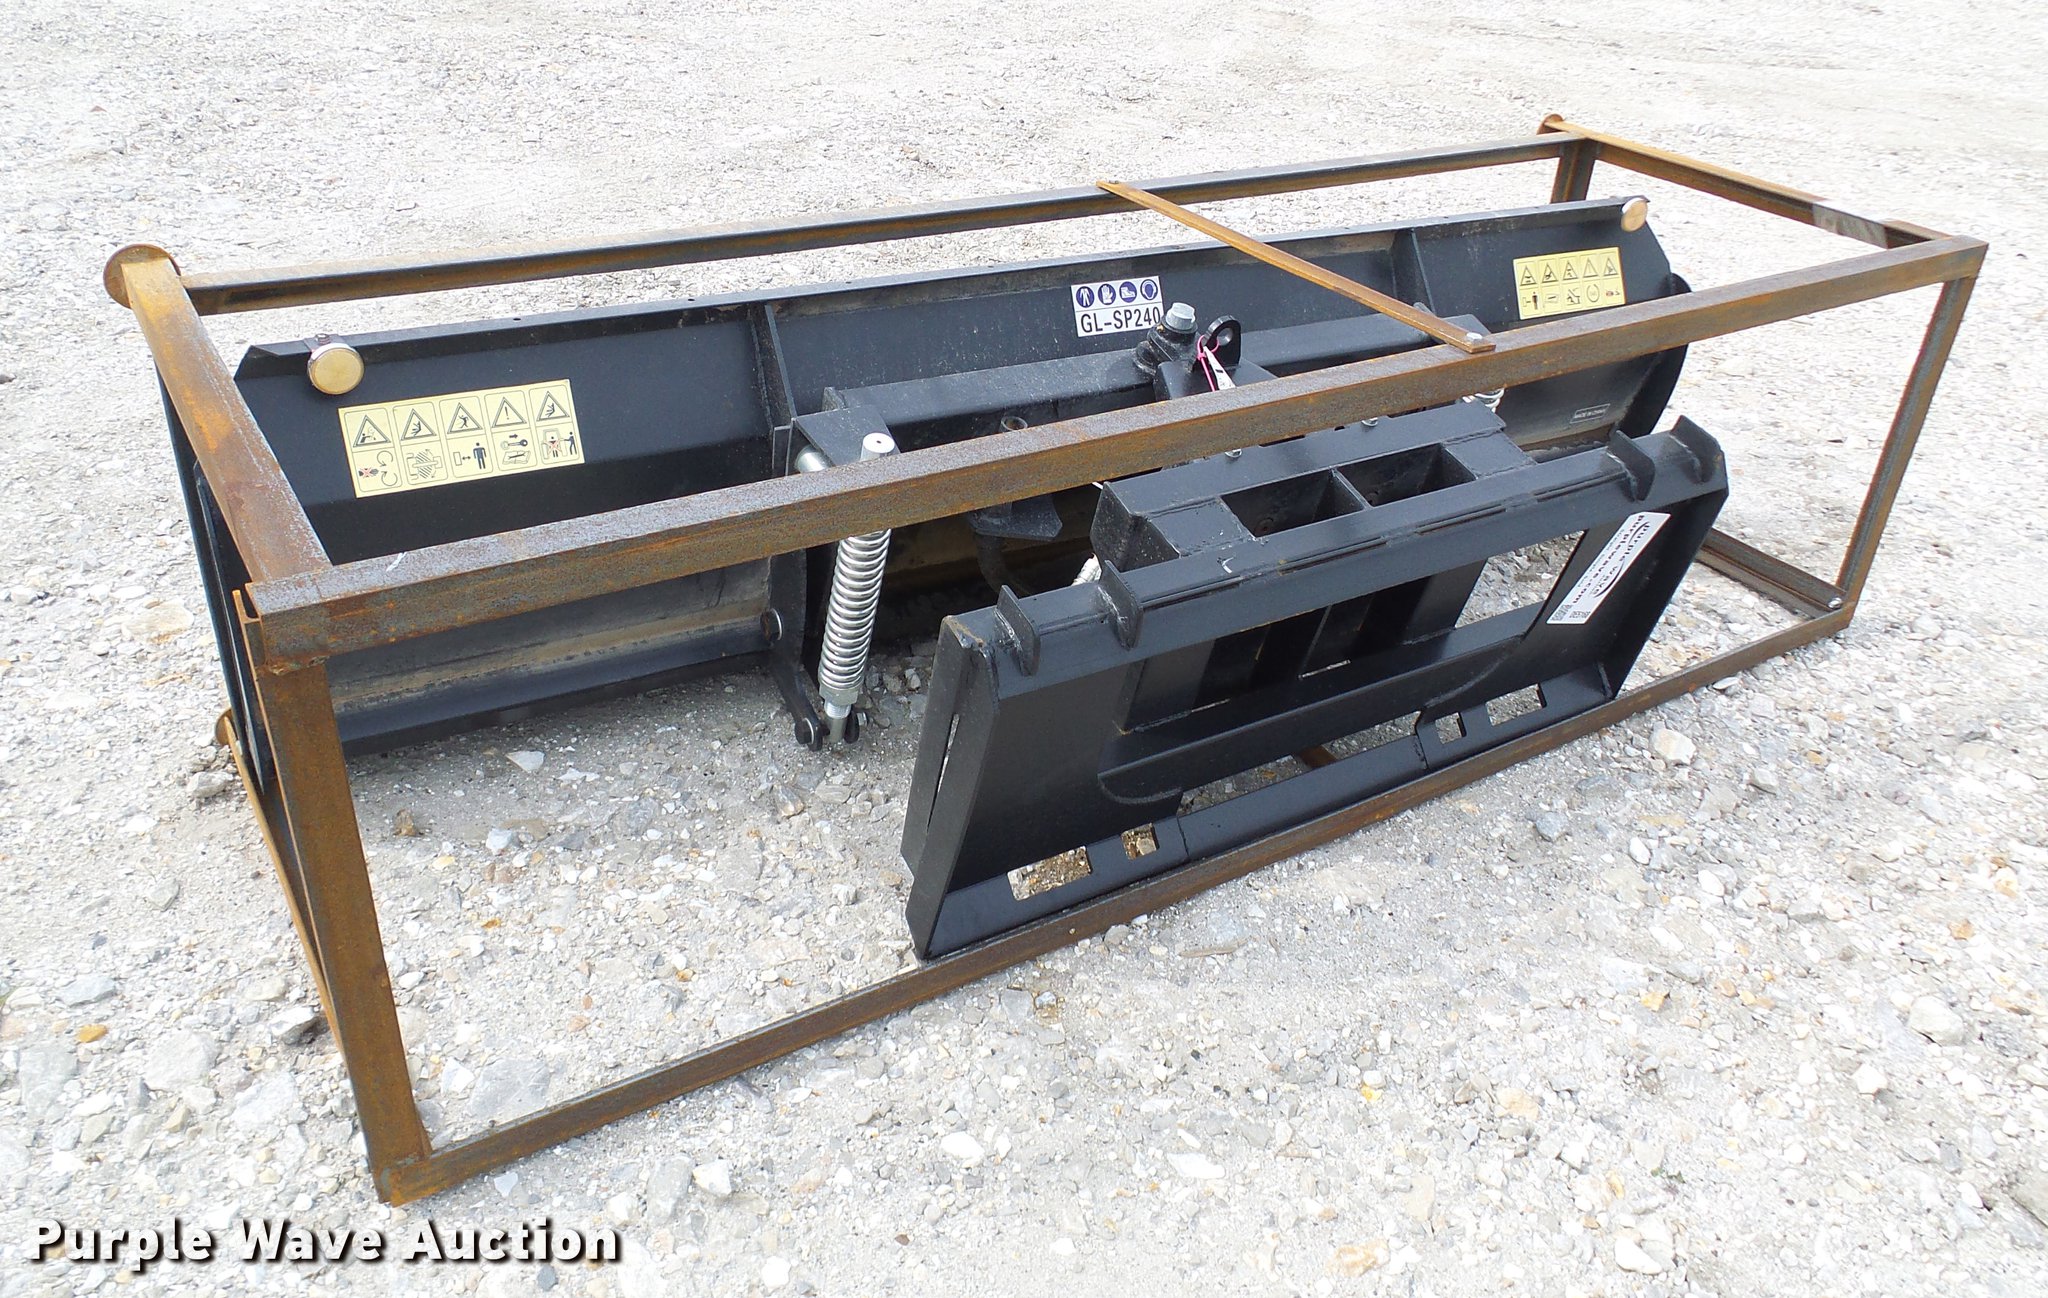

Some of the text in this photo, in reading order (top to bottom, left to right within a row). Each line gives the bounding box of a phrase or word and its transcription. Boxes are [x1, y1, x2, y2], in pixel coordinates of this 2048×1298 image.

[1081, 307, 1160, 334] GL-SP240
[1572, 515, 1645, 603] purplewave.com
[1618, 524, 1651, 561] purple
[1592, 566, 1618, 595] wave
